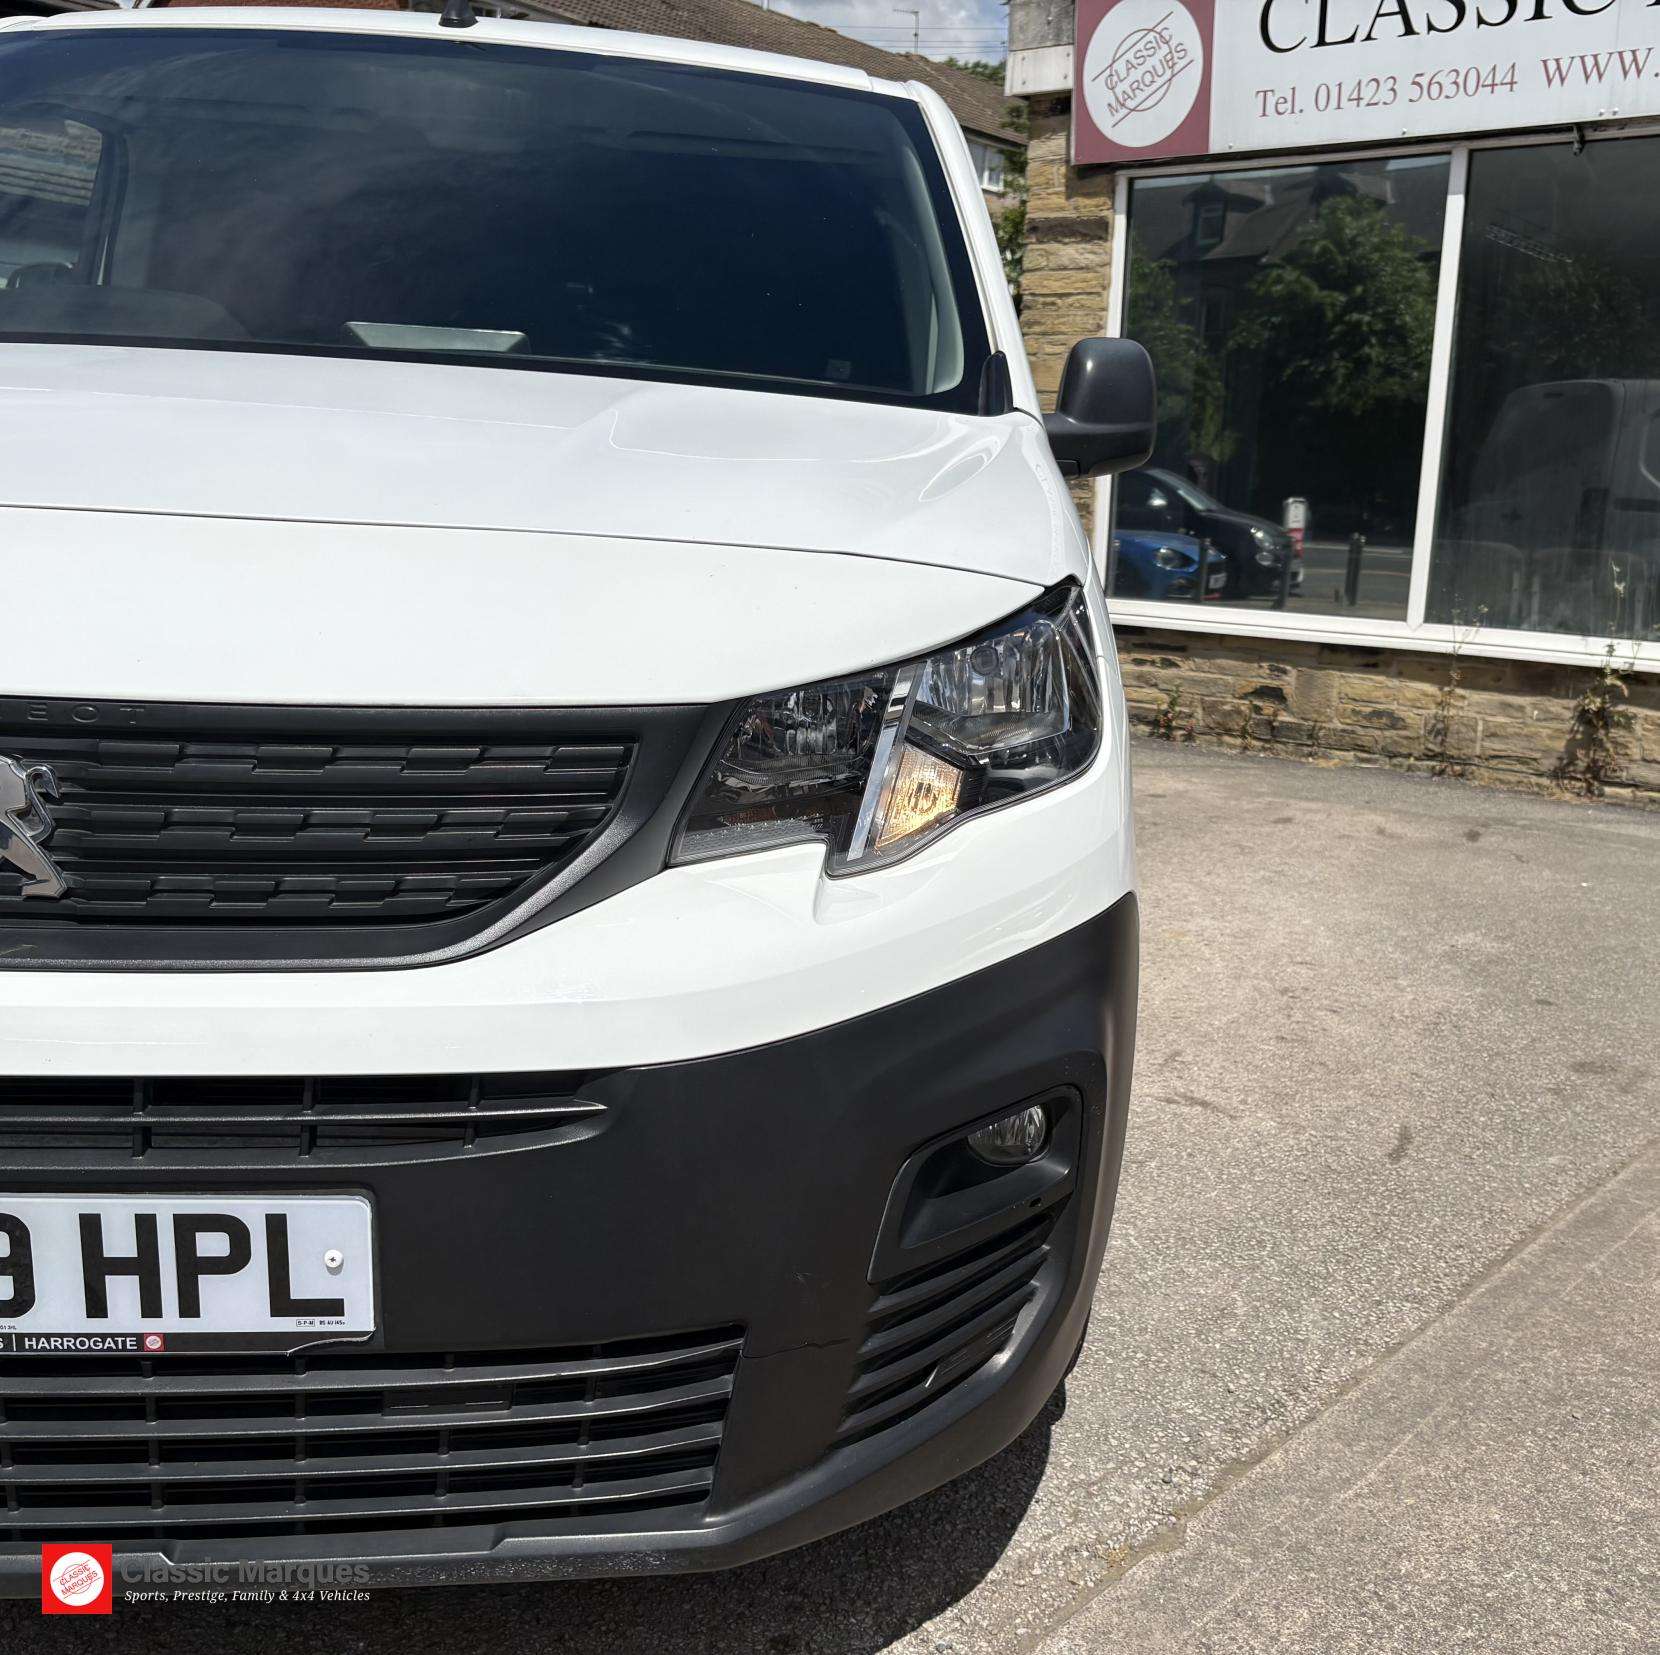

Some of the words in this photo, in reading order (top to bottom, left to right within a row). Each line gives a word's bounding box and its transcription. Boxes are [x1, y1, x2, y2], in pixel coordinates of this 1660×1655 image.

[1105, 27, 1173, 90] CLASSIC
[1107, 43, 1188, 116] MARQUES
[1255, 86, 1304, 117] Tel.
[1314, 76, 1399, 112] 01423
[1408, 62, 1518, 103] 563044
[78, 1212, 345, 1319] HPL
[24, 1336, 138, 1350] HARROGATE
